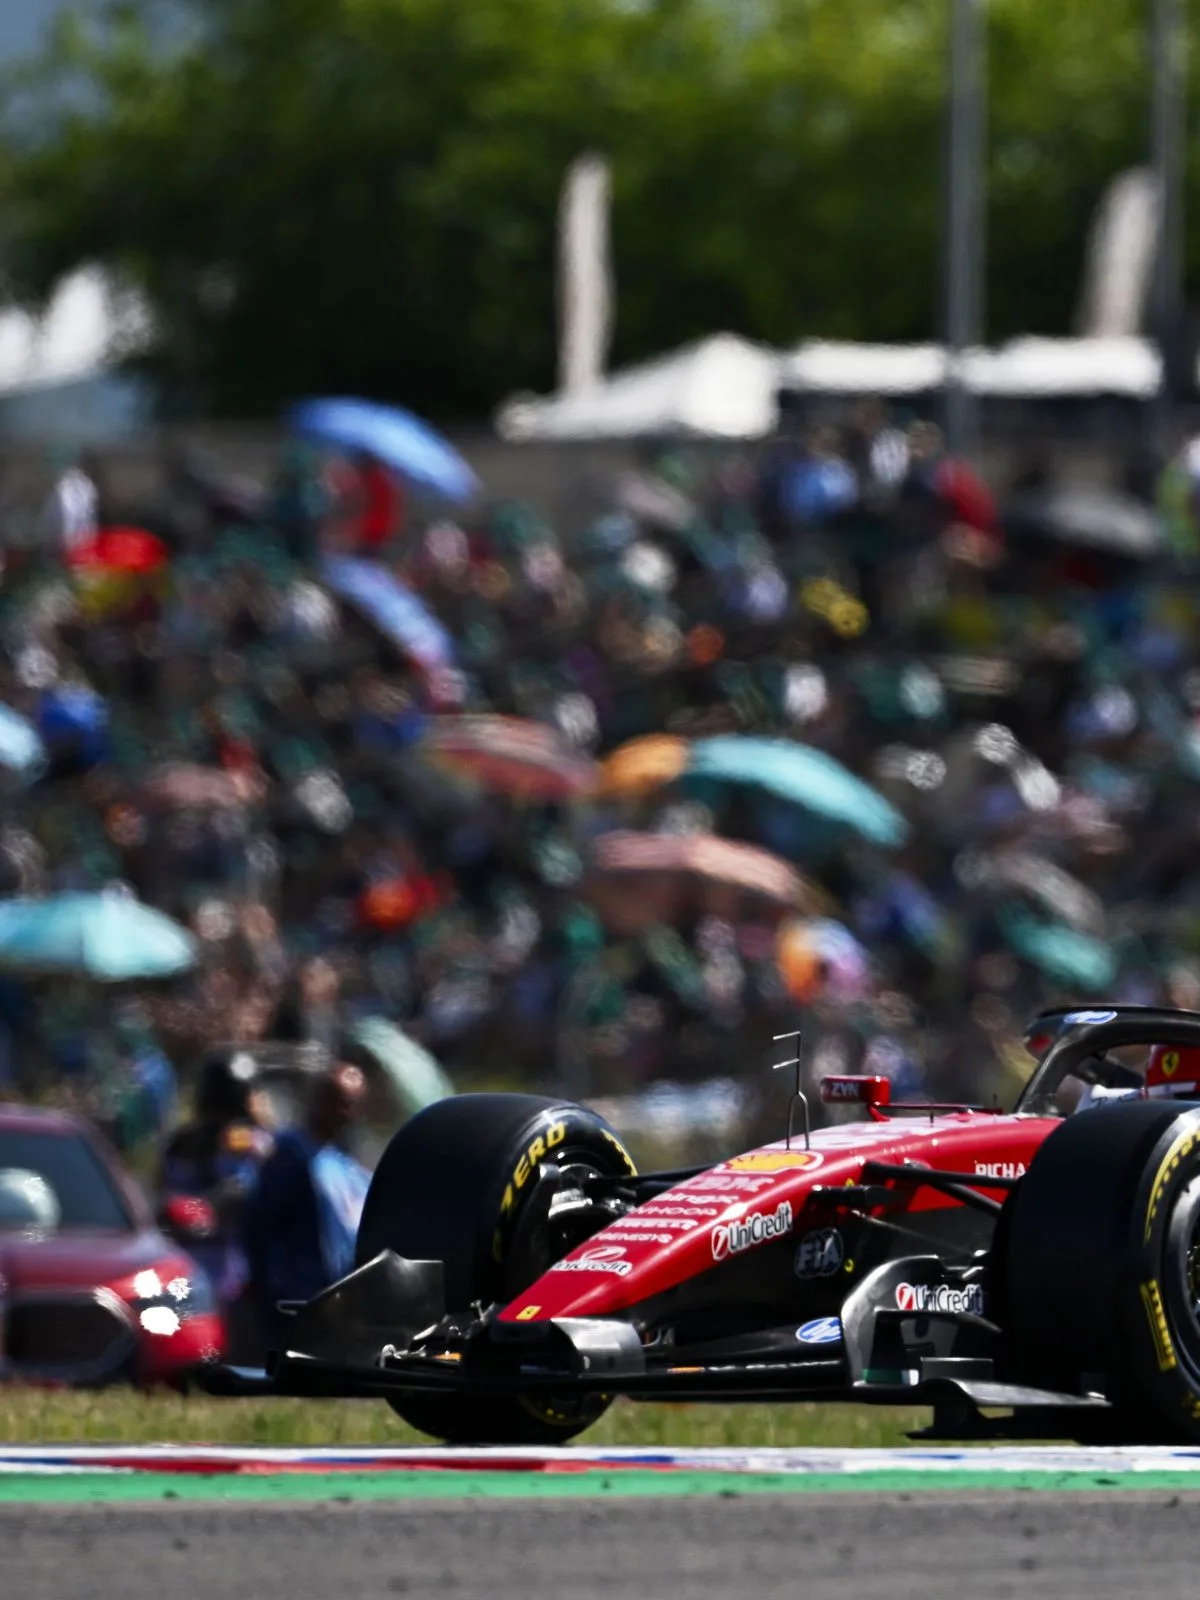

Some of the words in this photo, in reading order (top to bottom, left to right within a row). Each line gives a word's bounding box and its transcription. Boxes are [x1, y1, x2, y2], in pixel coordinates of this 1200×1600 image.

[831, 1082, 860, 1098] ZYN
[974, 1160, 1030, 1180] RICHA
[728, 1200, 793, 1252] UniCredit
[796, 1233, 841, 1273] FIA
